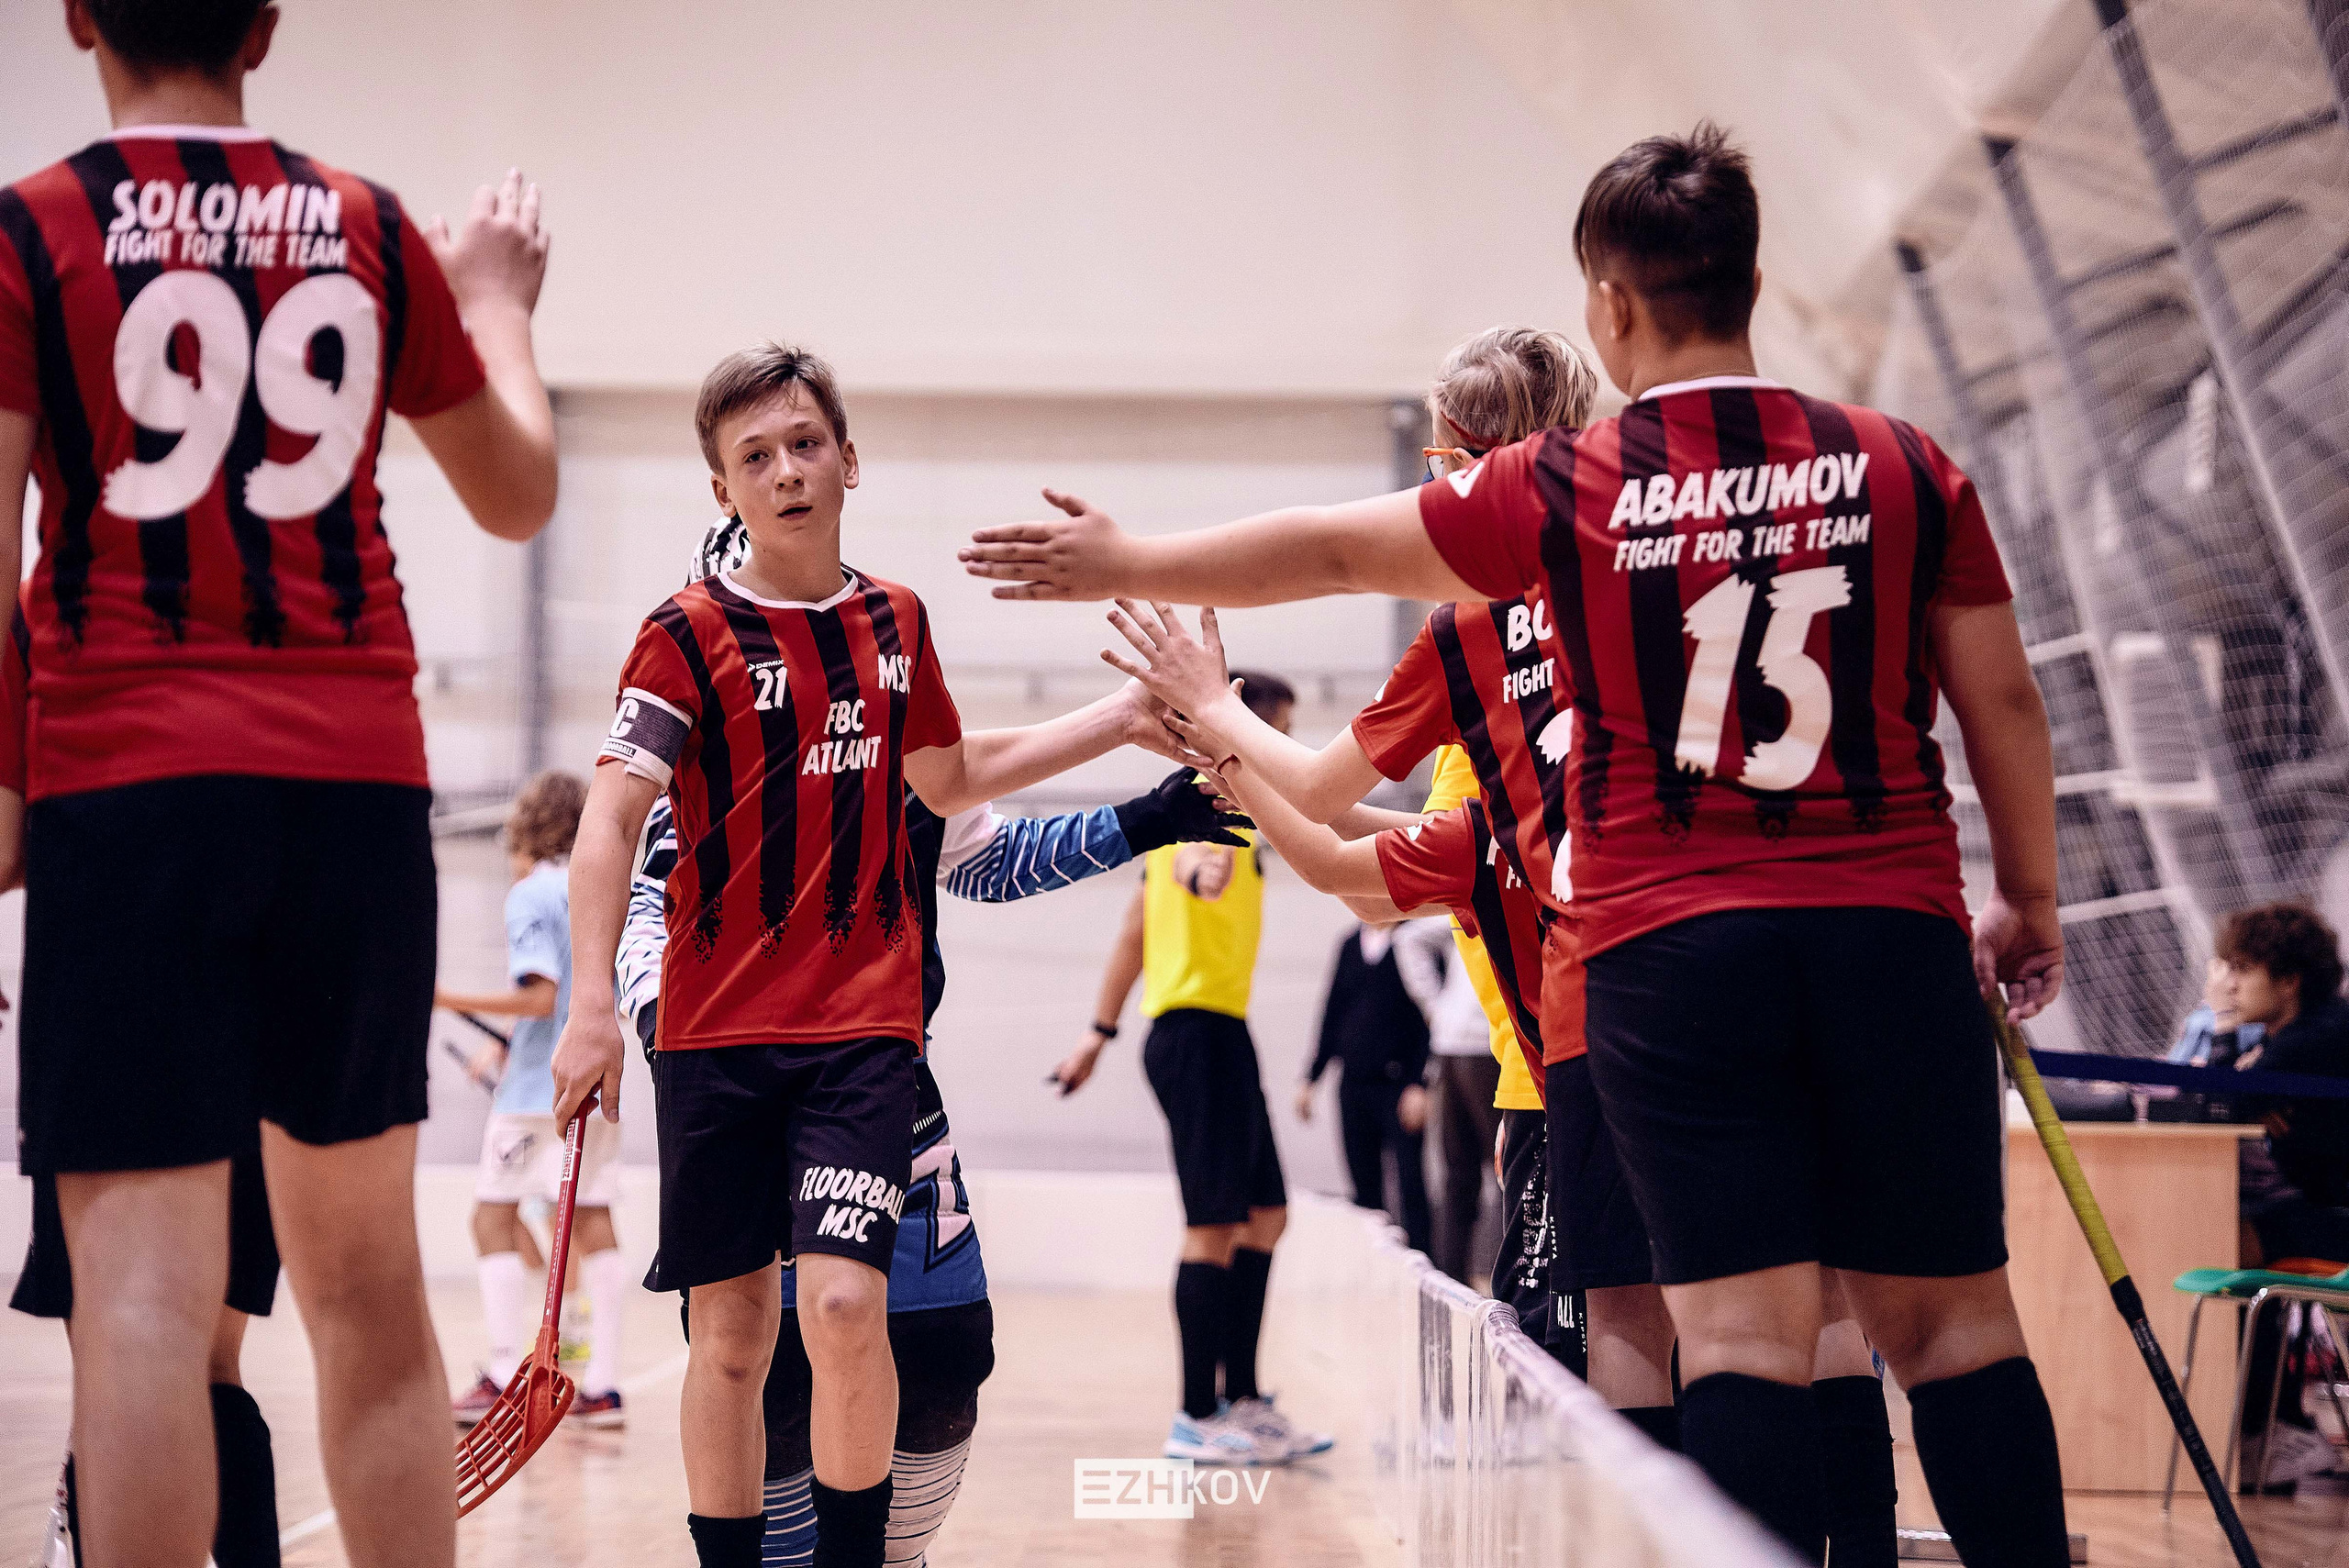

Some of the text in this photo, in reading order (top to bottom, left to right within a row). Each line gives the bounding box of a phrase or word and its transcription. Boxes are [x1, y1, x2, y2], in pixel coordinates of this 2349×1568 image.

[107, 180, 342, 233] SOLOMIN
[105, 229, 349, 268] FIGHT FOR THE TEAM
[103, 270, 383, 520] 99
[1608, 452, 1870, 530] ABAKUMOV
[1613, 514, 1871, 572] FIGHT FOR THE TEAM
[753, 666, 788, 711] 21
[878, 652, 912, 695] MSC
[1503, 658, 1555, 704] FIGHT
[1675, 565, 1854, 791] 15
[610, 698, 640, 738] C
[824, 699, 866, 735] FBC
[801, 735, 882, 775] ATLANT
[817, 1203, 878, 1243] MSC
[1549, 1216, 1558, 1260] KIPSTA
[1578, 1312, 1587, 1353] KIPSTA
